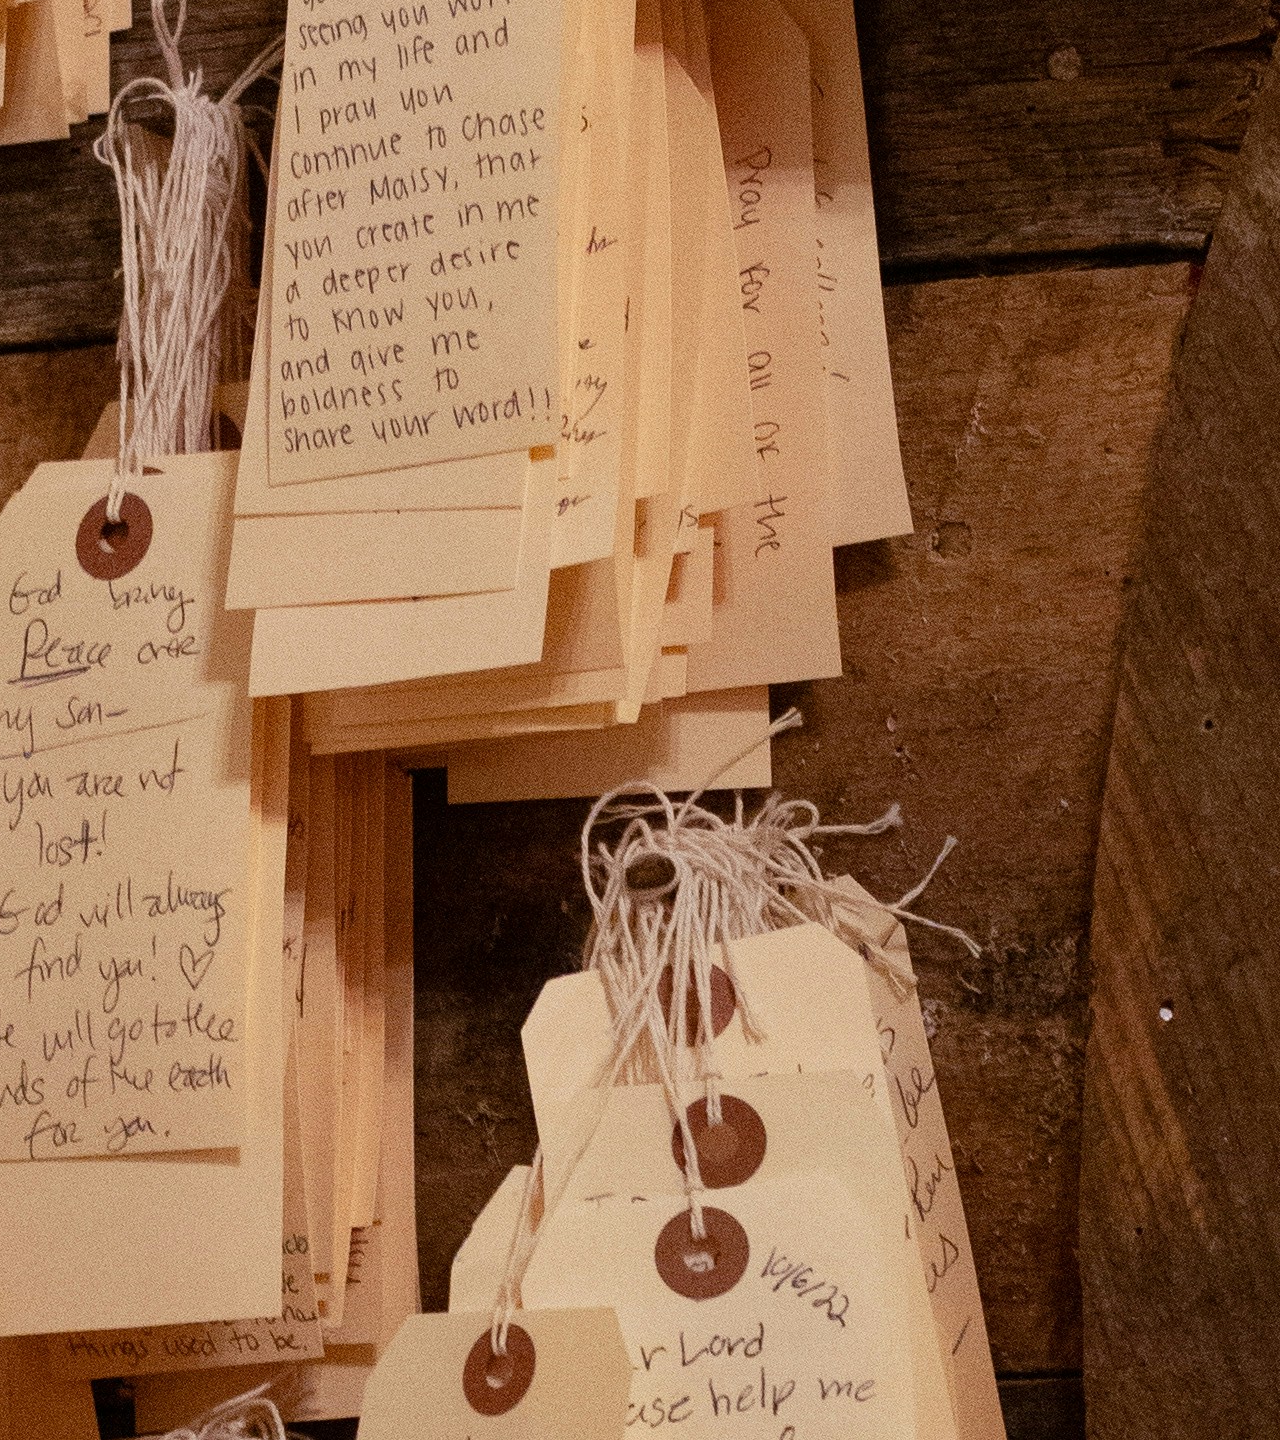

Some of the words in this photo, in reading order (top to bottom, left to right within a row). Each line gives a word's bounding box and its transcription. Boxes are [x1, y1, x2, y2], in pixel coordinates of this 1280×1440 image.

[301, 13, 368, 50] seeing
[381, 6, 429, 34] you
[292, 66, 317, 92] in
[338, 58, 377, 82] my
[396, 36, 436, 70] life
[454, 18, 510, 56] and
[287, 187, 348, 222] after
[475, 150, 541, 178] that
[281, 380, 402, 418] boldness
[434, 368, 460, 392] to
[372, 408, 436, 442] your
[78, 878, 132, 928] will
[142, 872, 232, 946] always
[16, 936, 82, 1000] find
[679, 1322, 765, 1368] Lord
[708, 1366, 796, 1417] help
[818, 1378, 876, 1402] me
